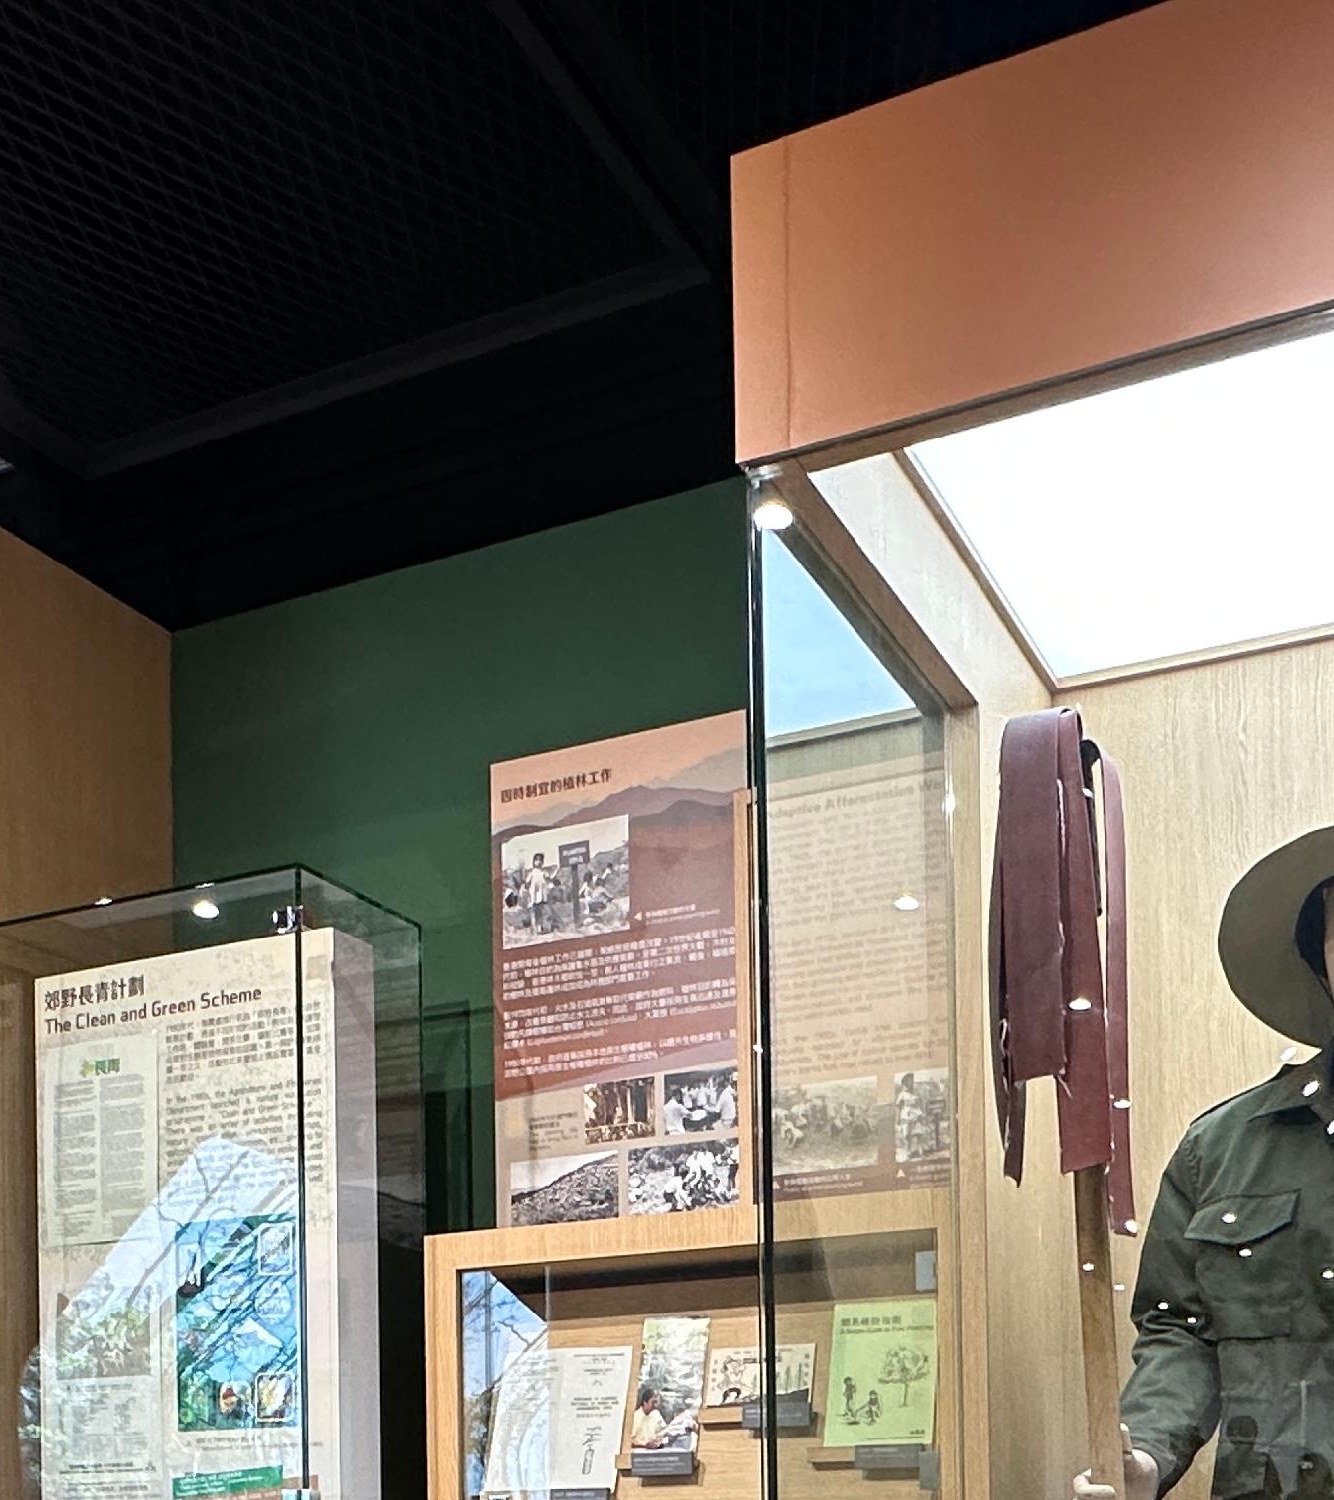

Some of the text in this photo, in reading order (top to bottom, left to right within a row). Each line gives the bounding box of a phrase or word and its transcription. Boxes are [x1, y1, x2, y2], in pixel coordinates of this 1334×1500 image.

[45, 989, 261, 1034] The Clean and Green Scheme
